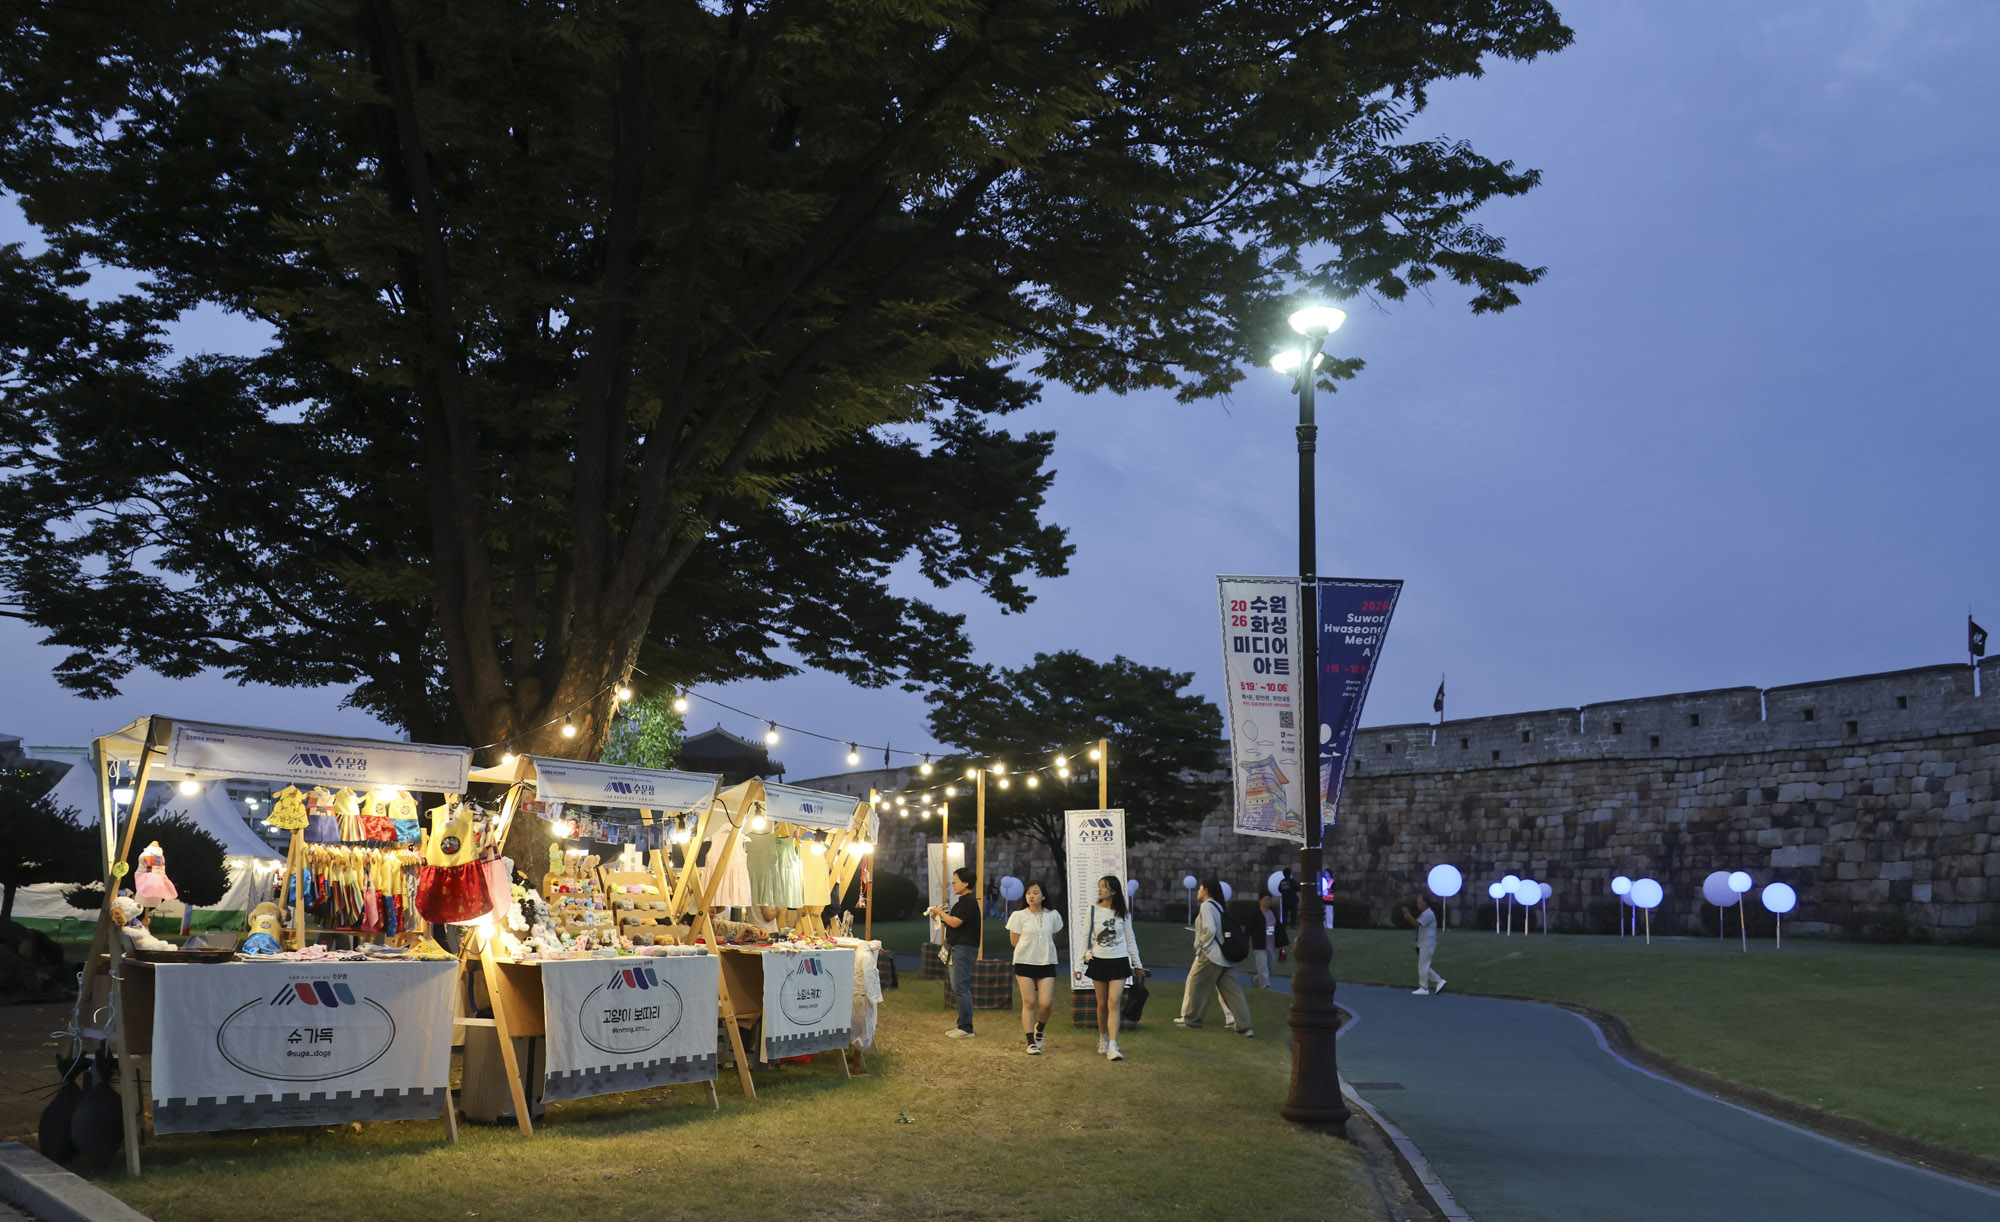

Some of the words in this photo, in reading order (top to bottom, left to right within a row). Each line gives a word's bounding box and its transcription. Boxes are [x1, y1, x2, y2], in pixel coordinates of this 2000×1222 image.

[1231, 600, 1247, 612] 20
[1250, 596, 1287, 614] 수원
[1231, 615, 1248, 627] 26
[1250, 616, 1288, 634] 화성
[1234, 636, 1288, 654] 미디어
[1253, 657, 1290, 675] 아트
[335, 756, 367, 771] 수문장
[634, 784, 655, 795] 수문장
[1078, 830, 1113, 842] 수문장
[603, 1008, 631, 1024] 고양이
[634, 1005, 660, 1021] 보따리
[287, 1028, 333, 1044] 슈가독
[286, 1050, 331, 1058] @suga_dogs
